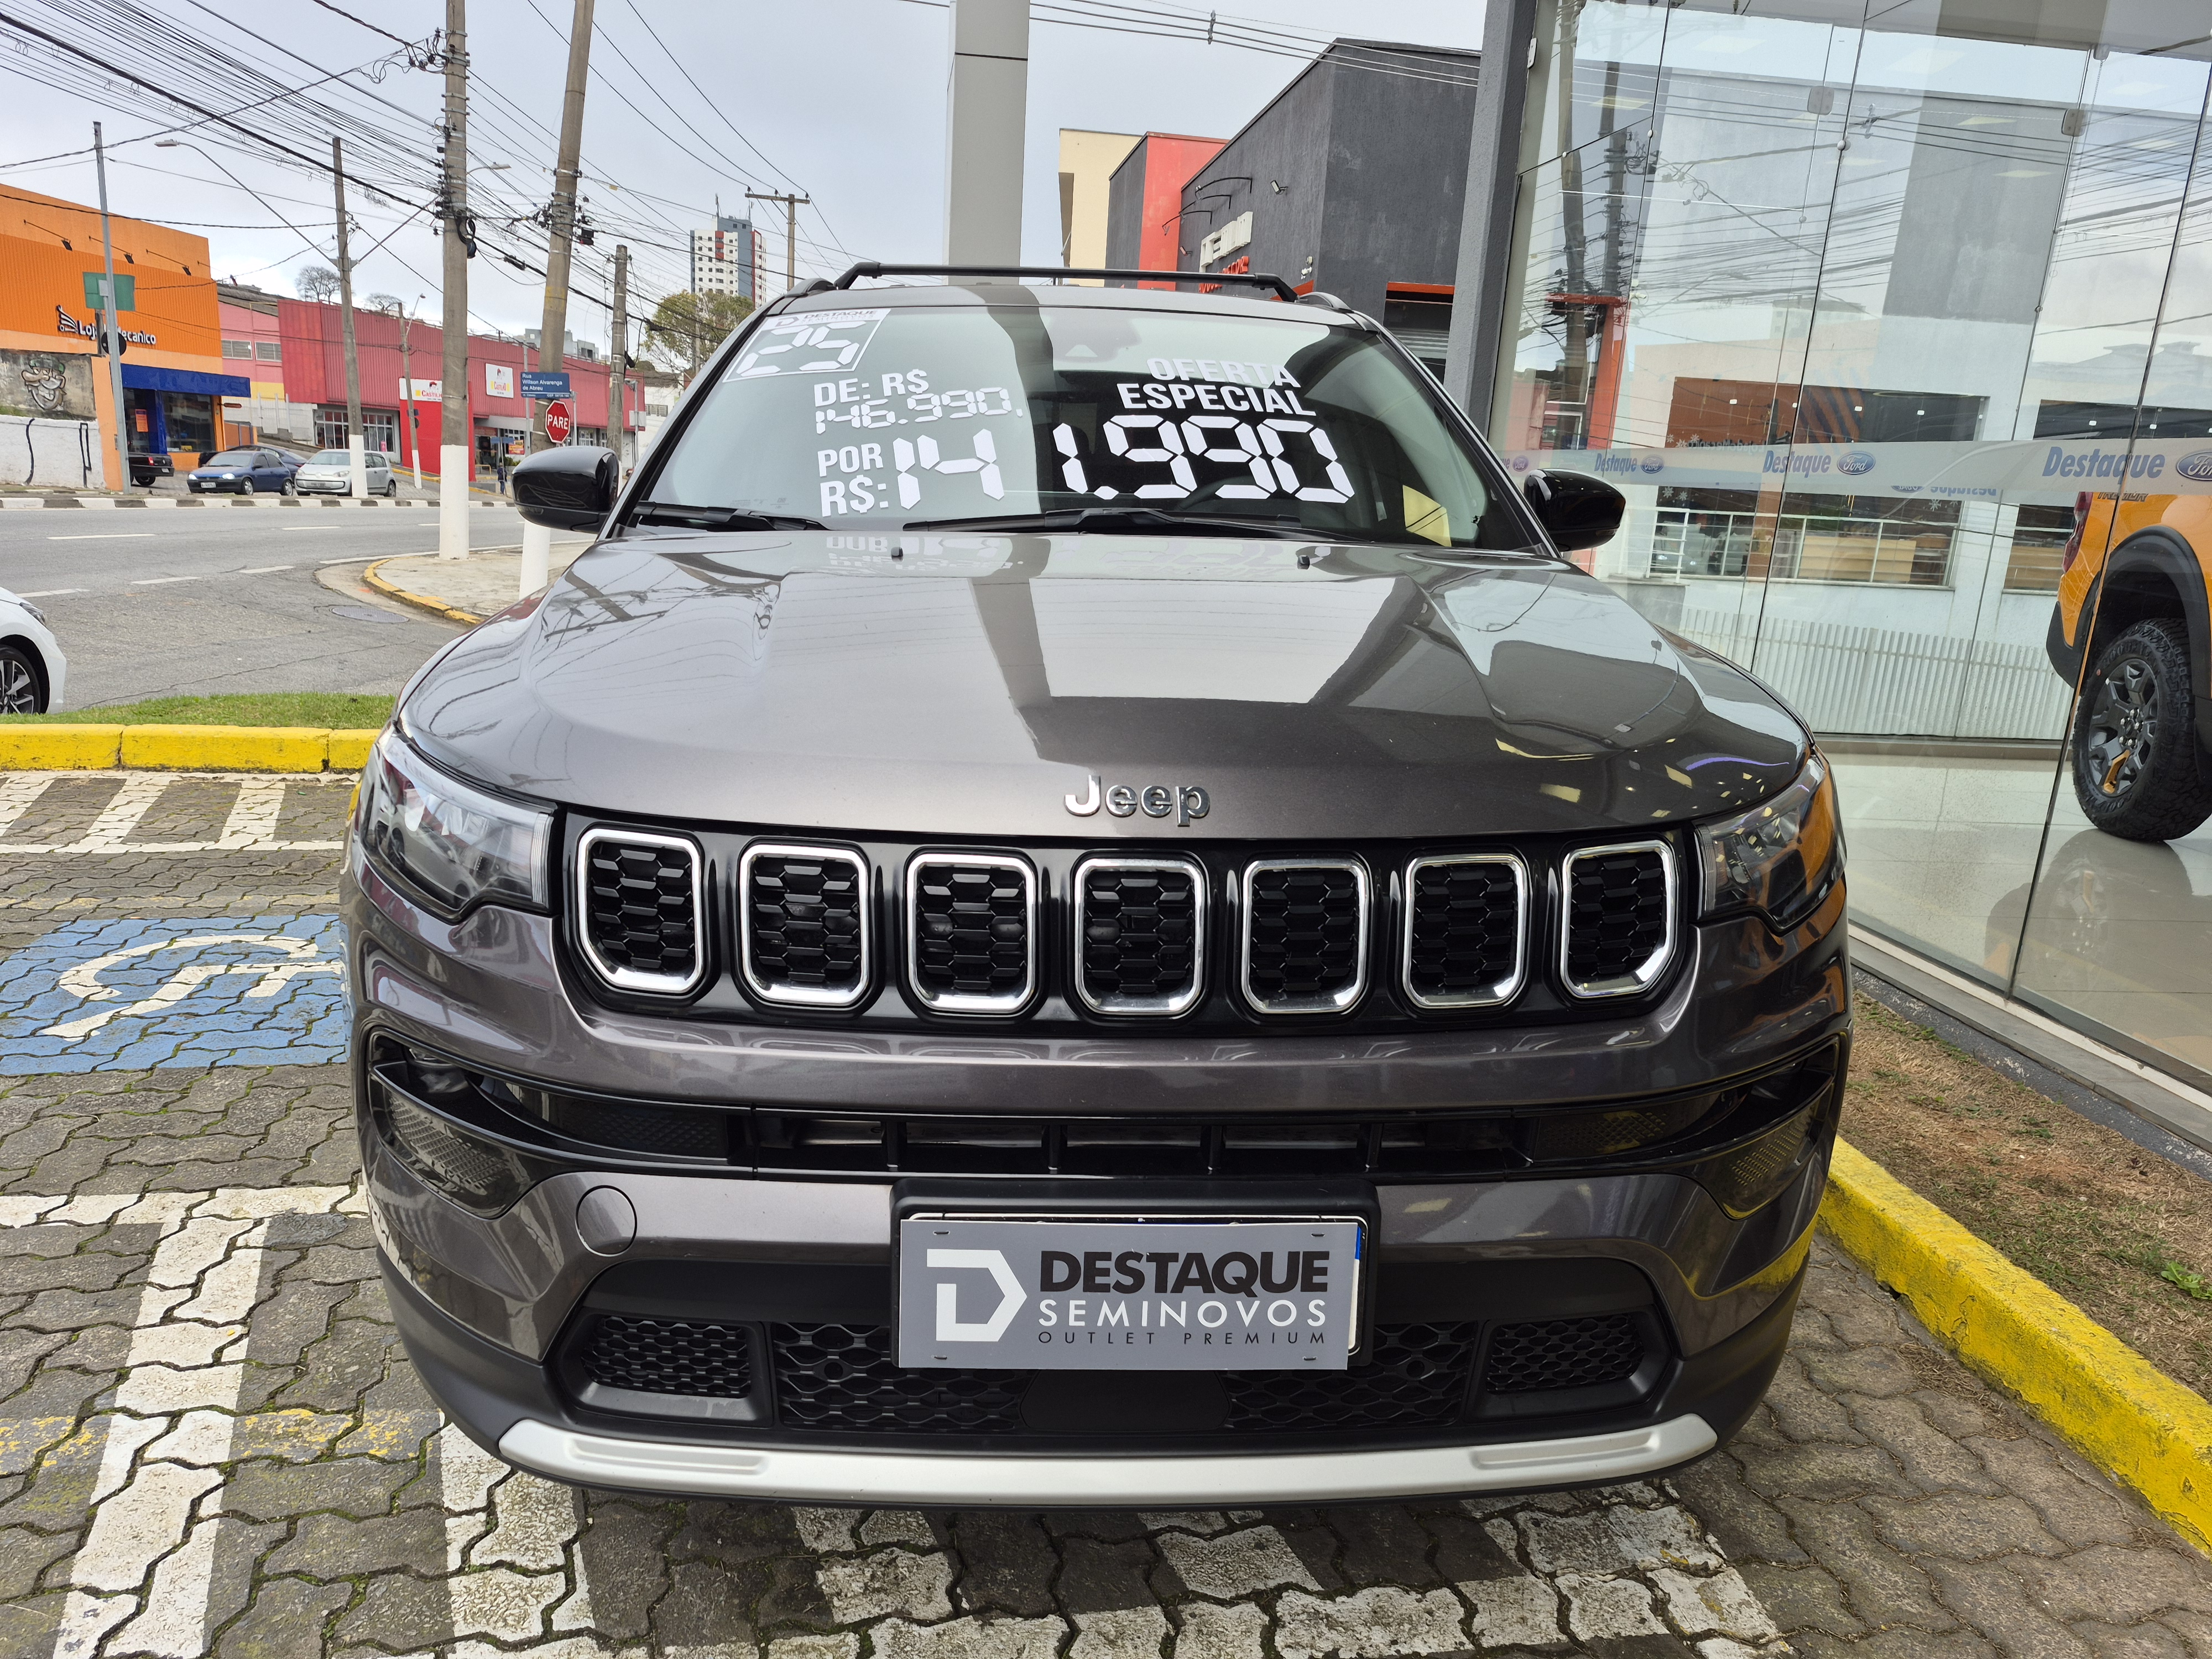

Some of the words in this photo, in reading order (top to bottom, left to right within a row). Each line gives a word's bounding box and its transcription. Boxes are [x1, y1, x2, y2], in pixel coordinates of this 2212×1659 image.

[804, 310, 878, 319] DESTAQUE
[736, 321, 866, 377] 25
[814, 378, 870, 407] DE:
[881, 369, 929, 397] R$
[1146, 358, 1301, 388] OFERTA
[1117, 383, 1316, 416] ESPECIAL
[547, 414, 568, 430] PARE
[817, 443, 884, 477] POR
[1594, 453, 1637, 476] Destaque
[1762, 450, 1831, 478] Destaque
[2042, 446, 2165, 485] Destaque
[820, 474, 889, 517] R$:
[1064, 774, 1211, 827] Jeep
[1040, 1250, 1329, 1298] DESTAQUE
[1039, 1300, 1326, 1328] SEMINOVOS
[1038, 1332, 1156, 1345] OUTLET
[1183, 1332, 1325, 1345] PREMIUM
